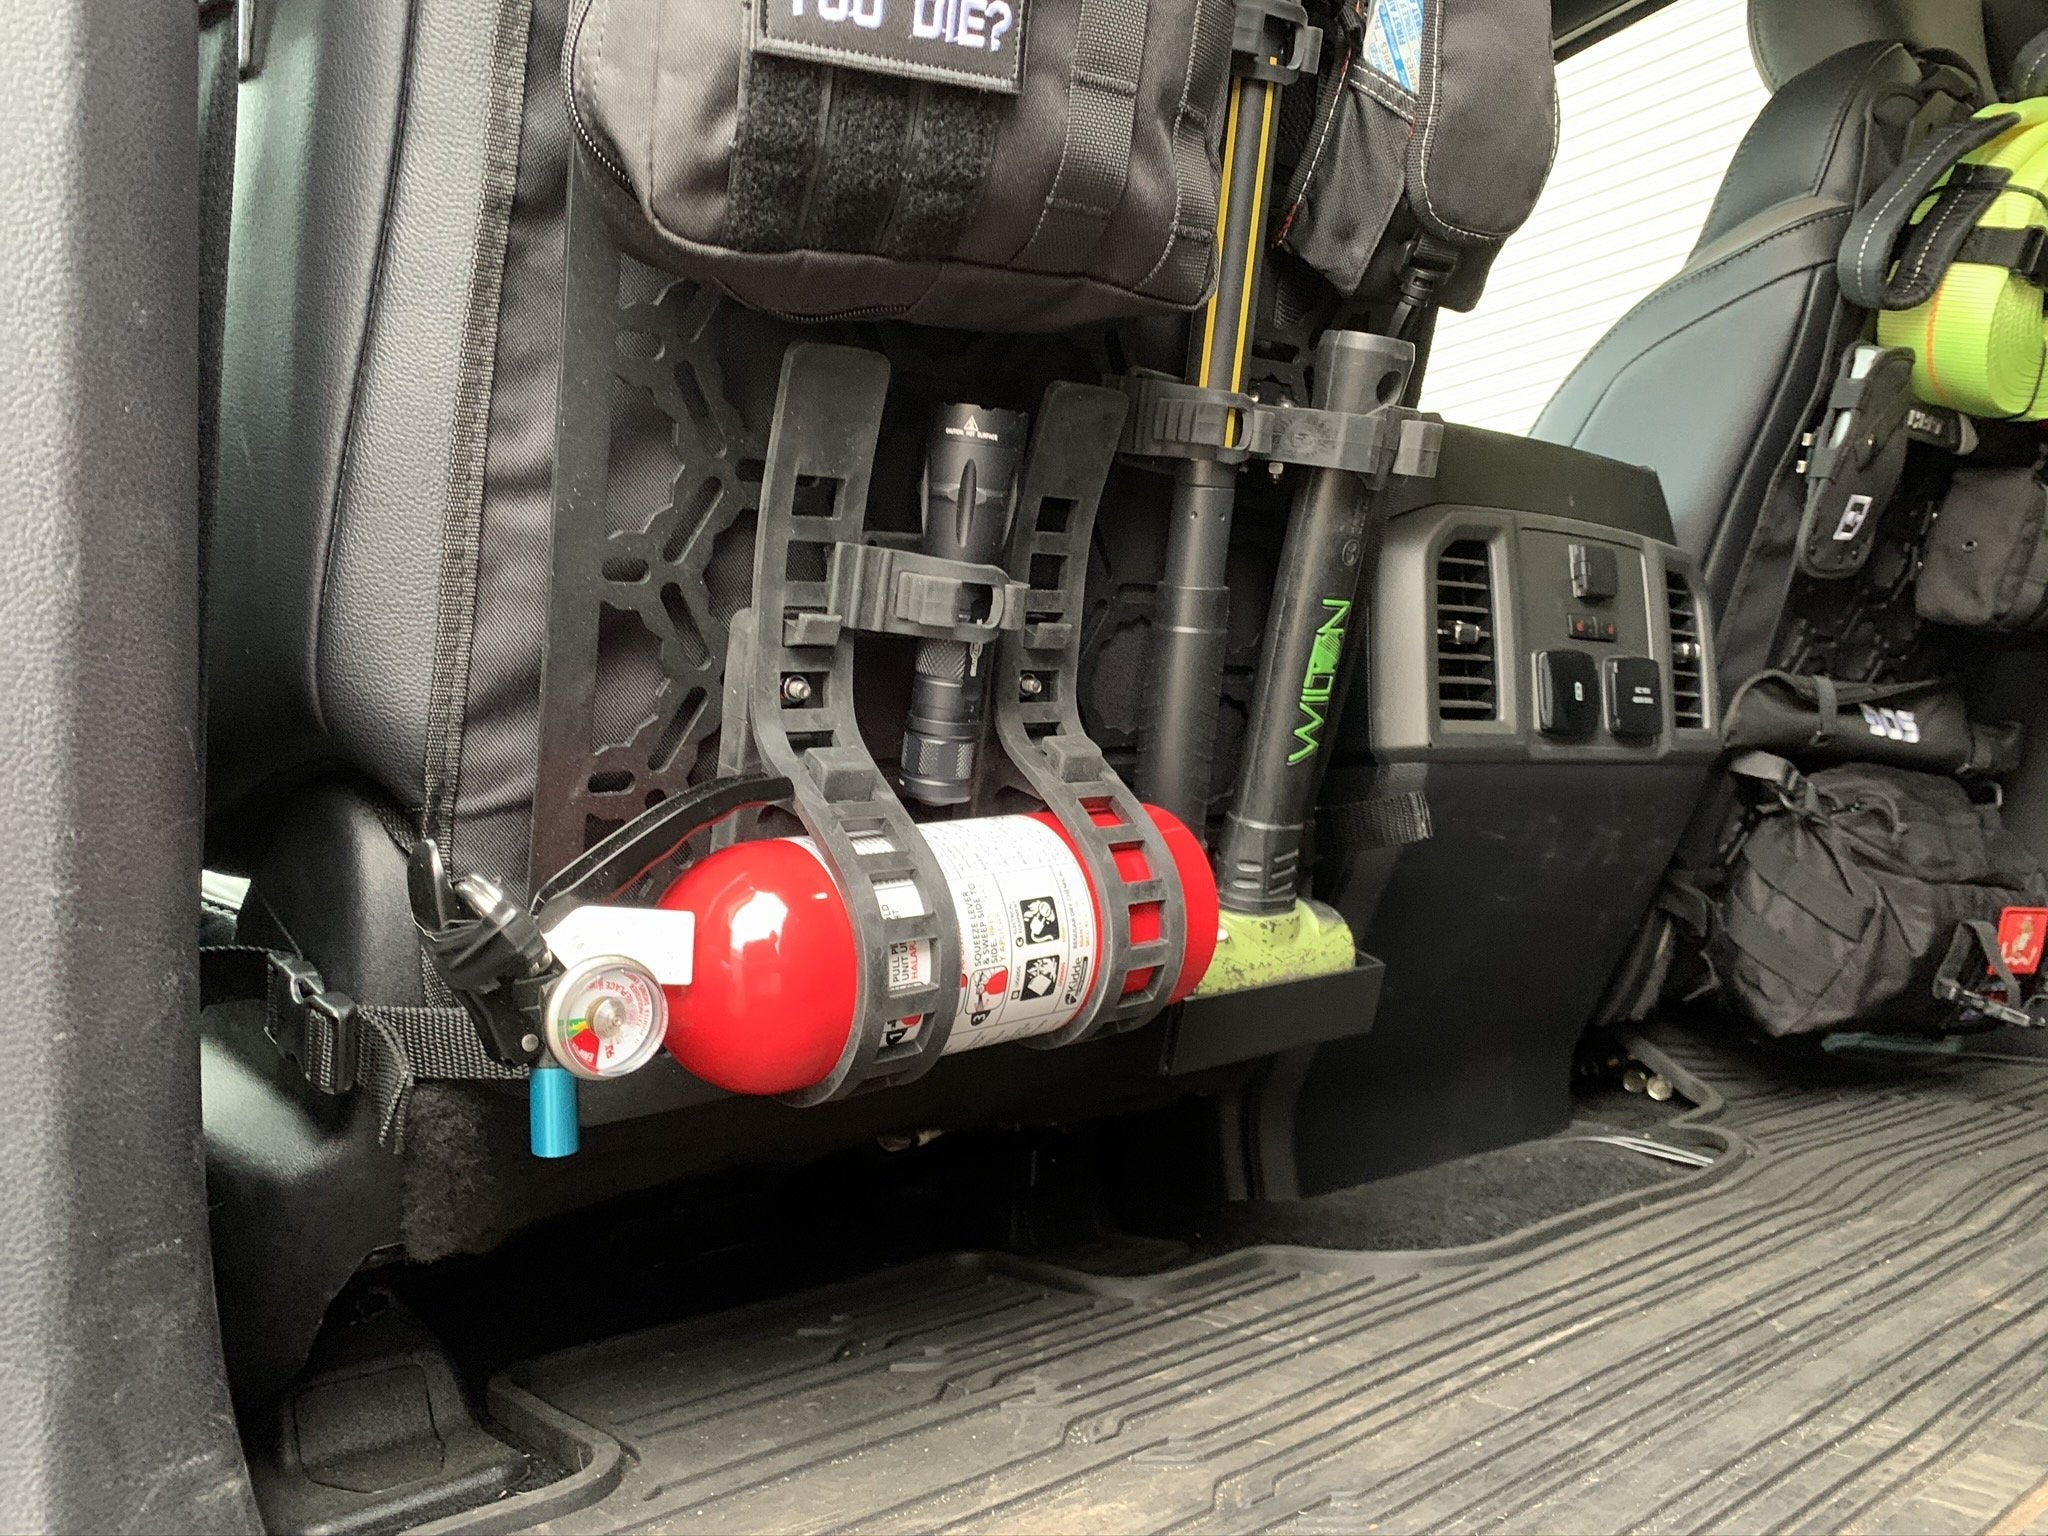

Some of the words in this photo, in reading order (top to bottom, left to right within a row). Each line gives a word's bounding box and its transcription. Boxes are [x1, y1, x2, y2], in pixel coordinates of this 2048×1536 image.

[912, 0, 1013, 51] DIE?
[1393, 17, 1405, 45] FIRST
[968, 883, 979, 895] TO
[963, 892, 977, 919] LEVER
[974, 898, 984, 919] SIDE
[971, 923, 982, 967] SQUEEZE
[979, 922, 989, 954] SWEEP
[892, 957, 901, 982] PULL
[901, 956, 910, 981] UNIT
[982, 957, 989, 965] &
[1065, 957, 1082, 992] Kidde
[974, 1014, 985, 1022] 3
